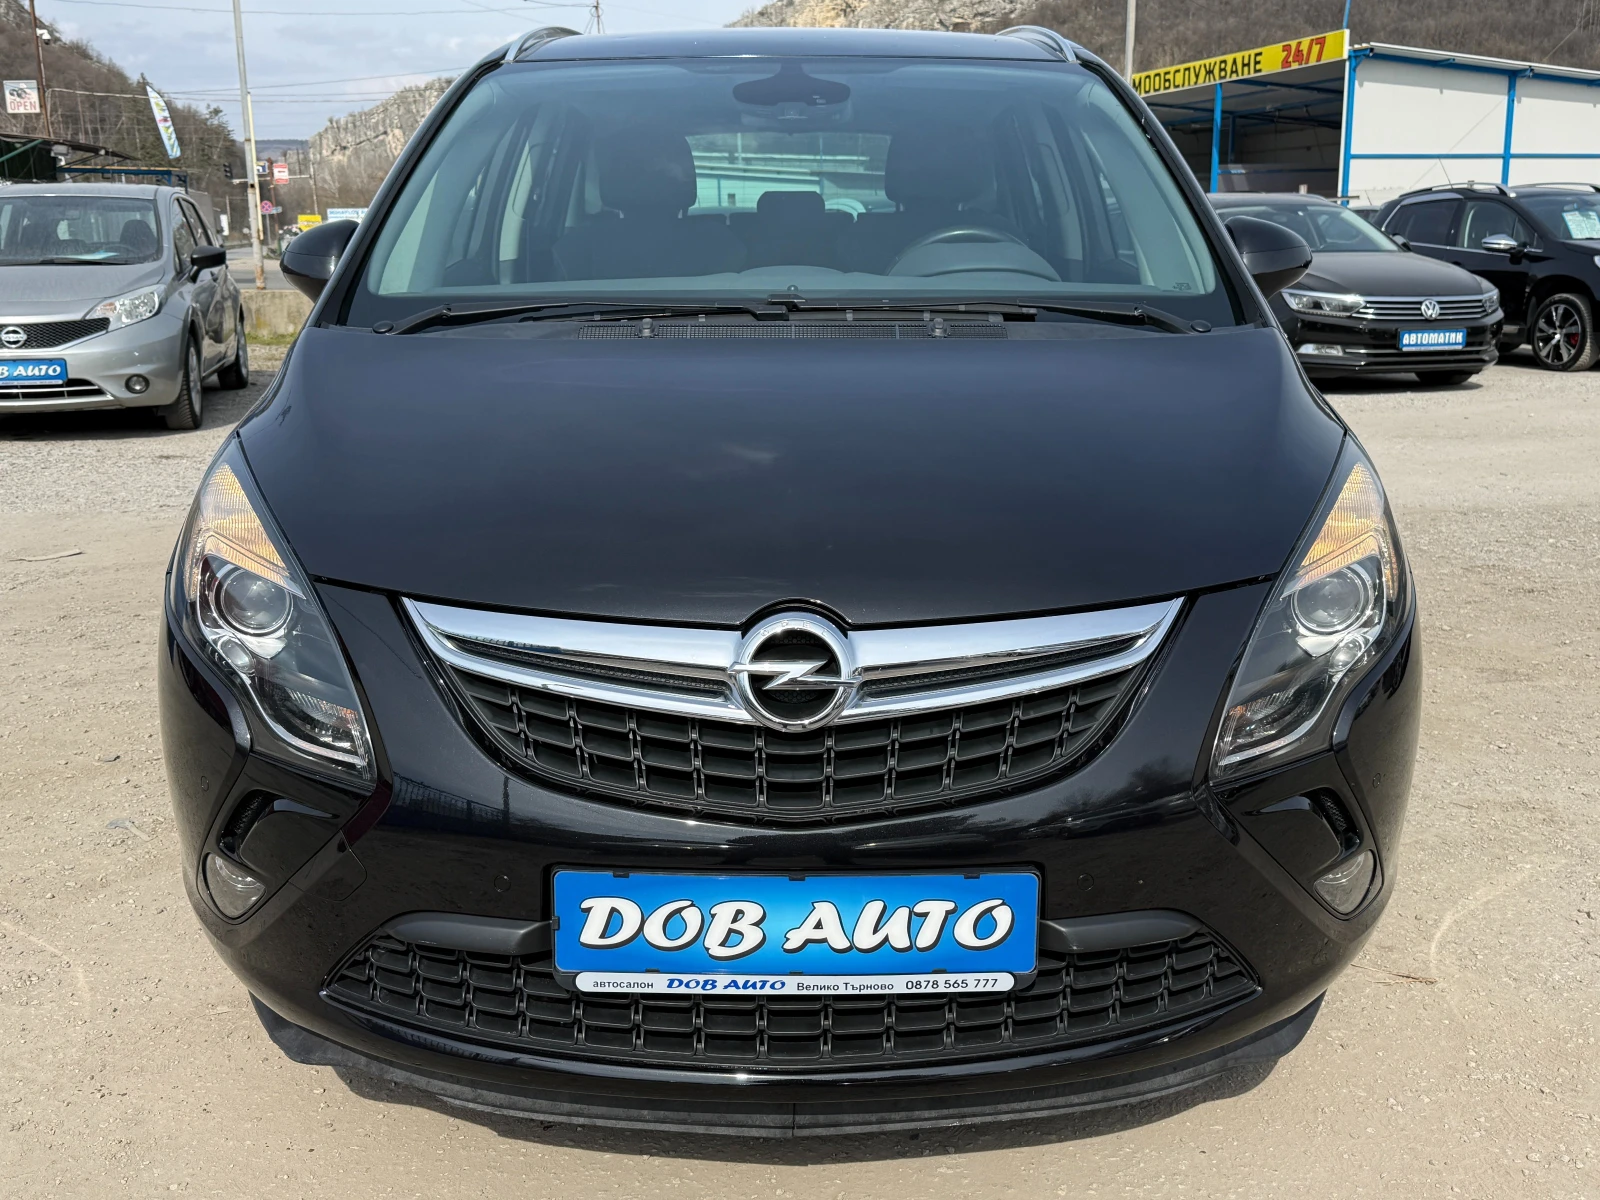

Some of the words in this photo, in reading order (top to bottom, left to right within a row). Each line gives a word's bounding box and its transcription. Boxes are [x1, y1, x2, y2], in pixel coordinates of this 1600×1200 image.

[1281, 36, 1327, 70] 24/7
[9, 100, 37, 111] OPEN
[1402, 332, 1463, 345] АВТОМАТИК
[13, 365, 61, 377] AUTO
[579, 896, 767, 961] DOB
[782, 898, 1015, 953] AUTO
[592, 980, 654, 989] автосалон
[666, 978, 718, 991] DOB
[723, 979, 786, 991] AUTO
[796, 982, 839, 991] Велико
[843, 982, 895, 992] Търново
[905, 980, 940, 990] 0878
[943, 979, 969, 989] 565
[973, 978, 999, 989] 777
